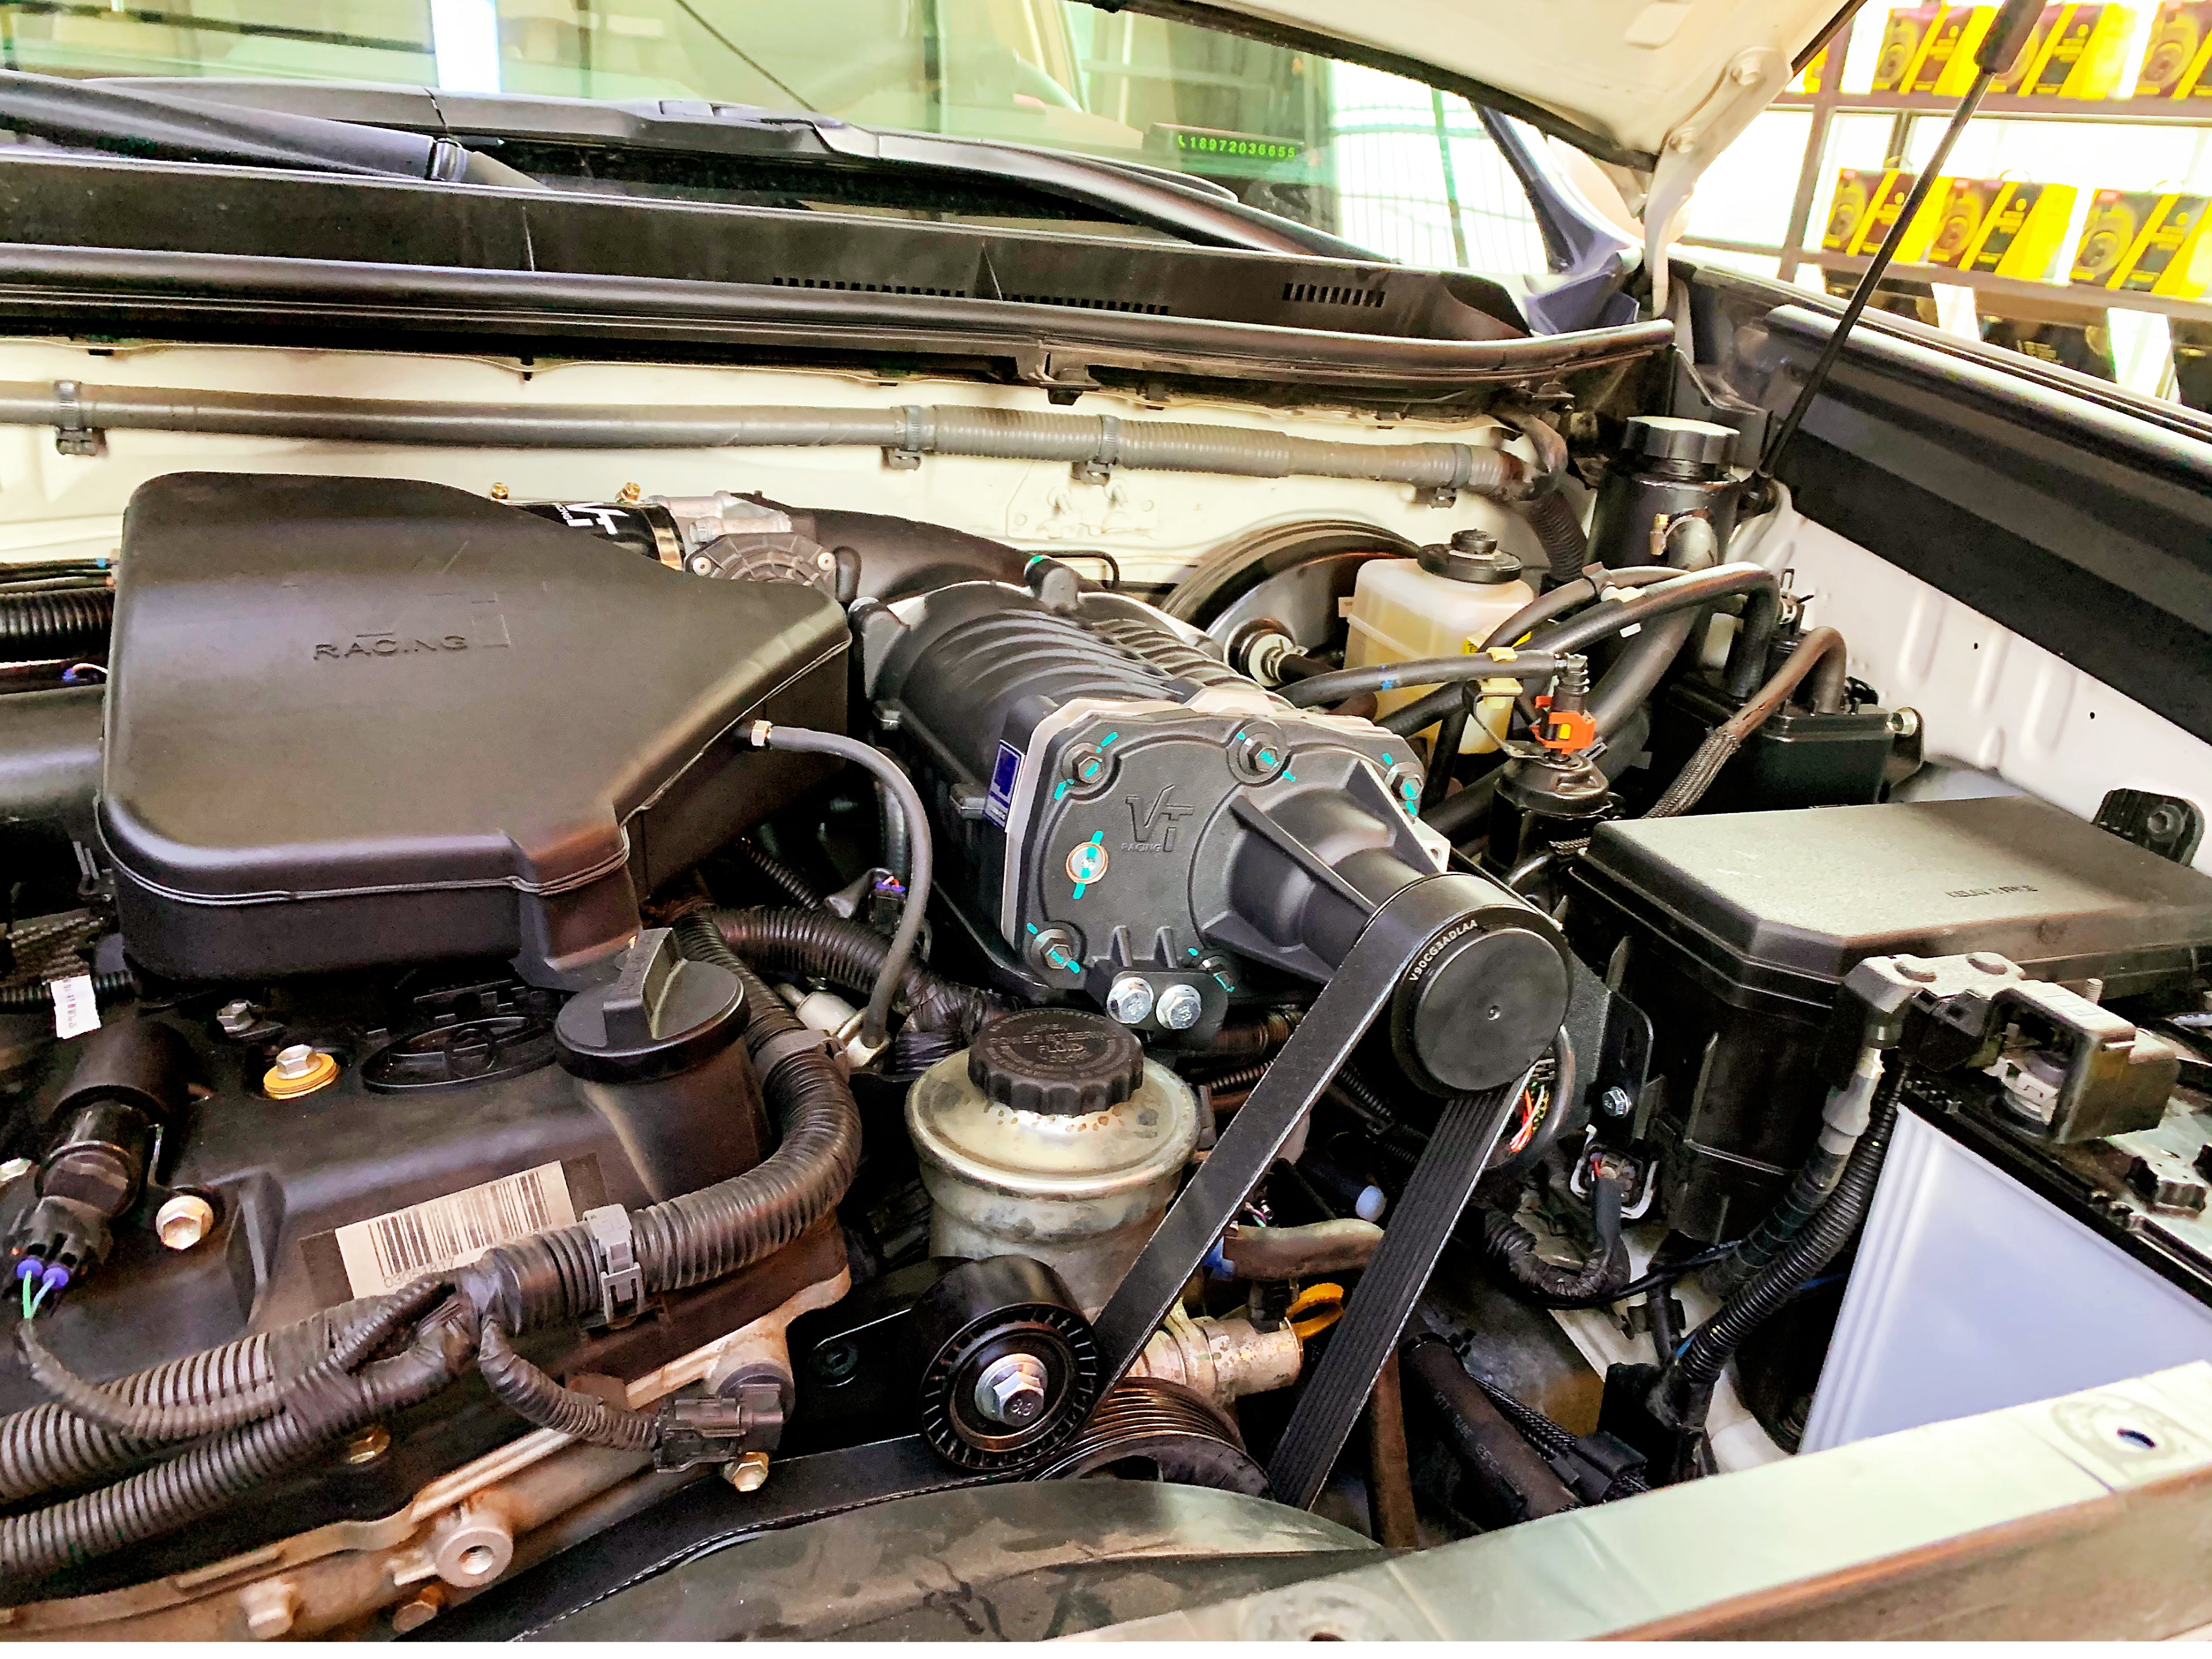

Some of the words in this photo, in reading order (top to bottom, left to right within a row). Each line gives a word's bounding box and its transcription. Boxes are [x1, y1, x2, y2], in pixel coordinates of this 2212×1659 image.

[314, 635, 469, 661] RACING
[1121, 843, 1162, 853] RACING
[1039, 1043, 1084, 1053] FLUID
